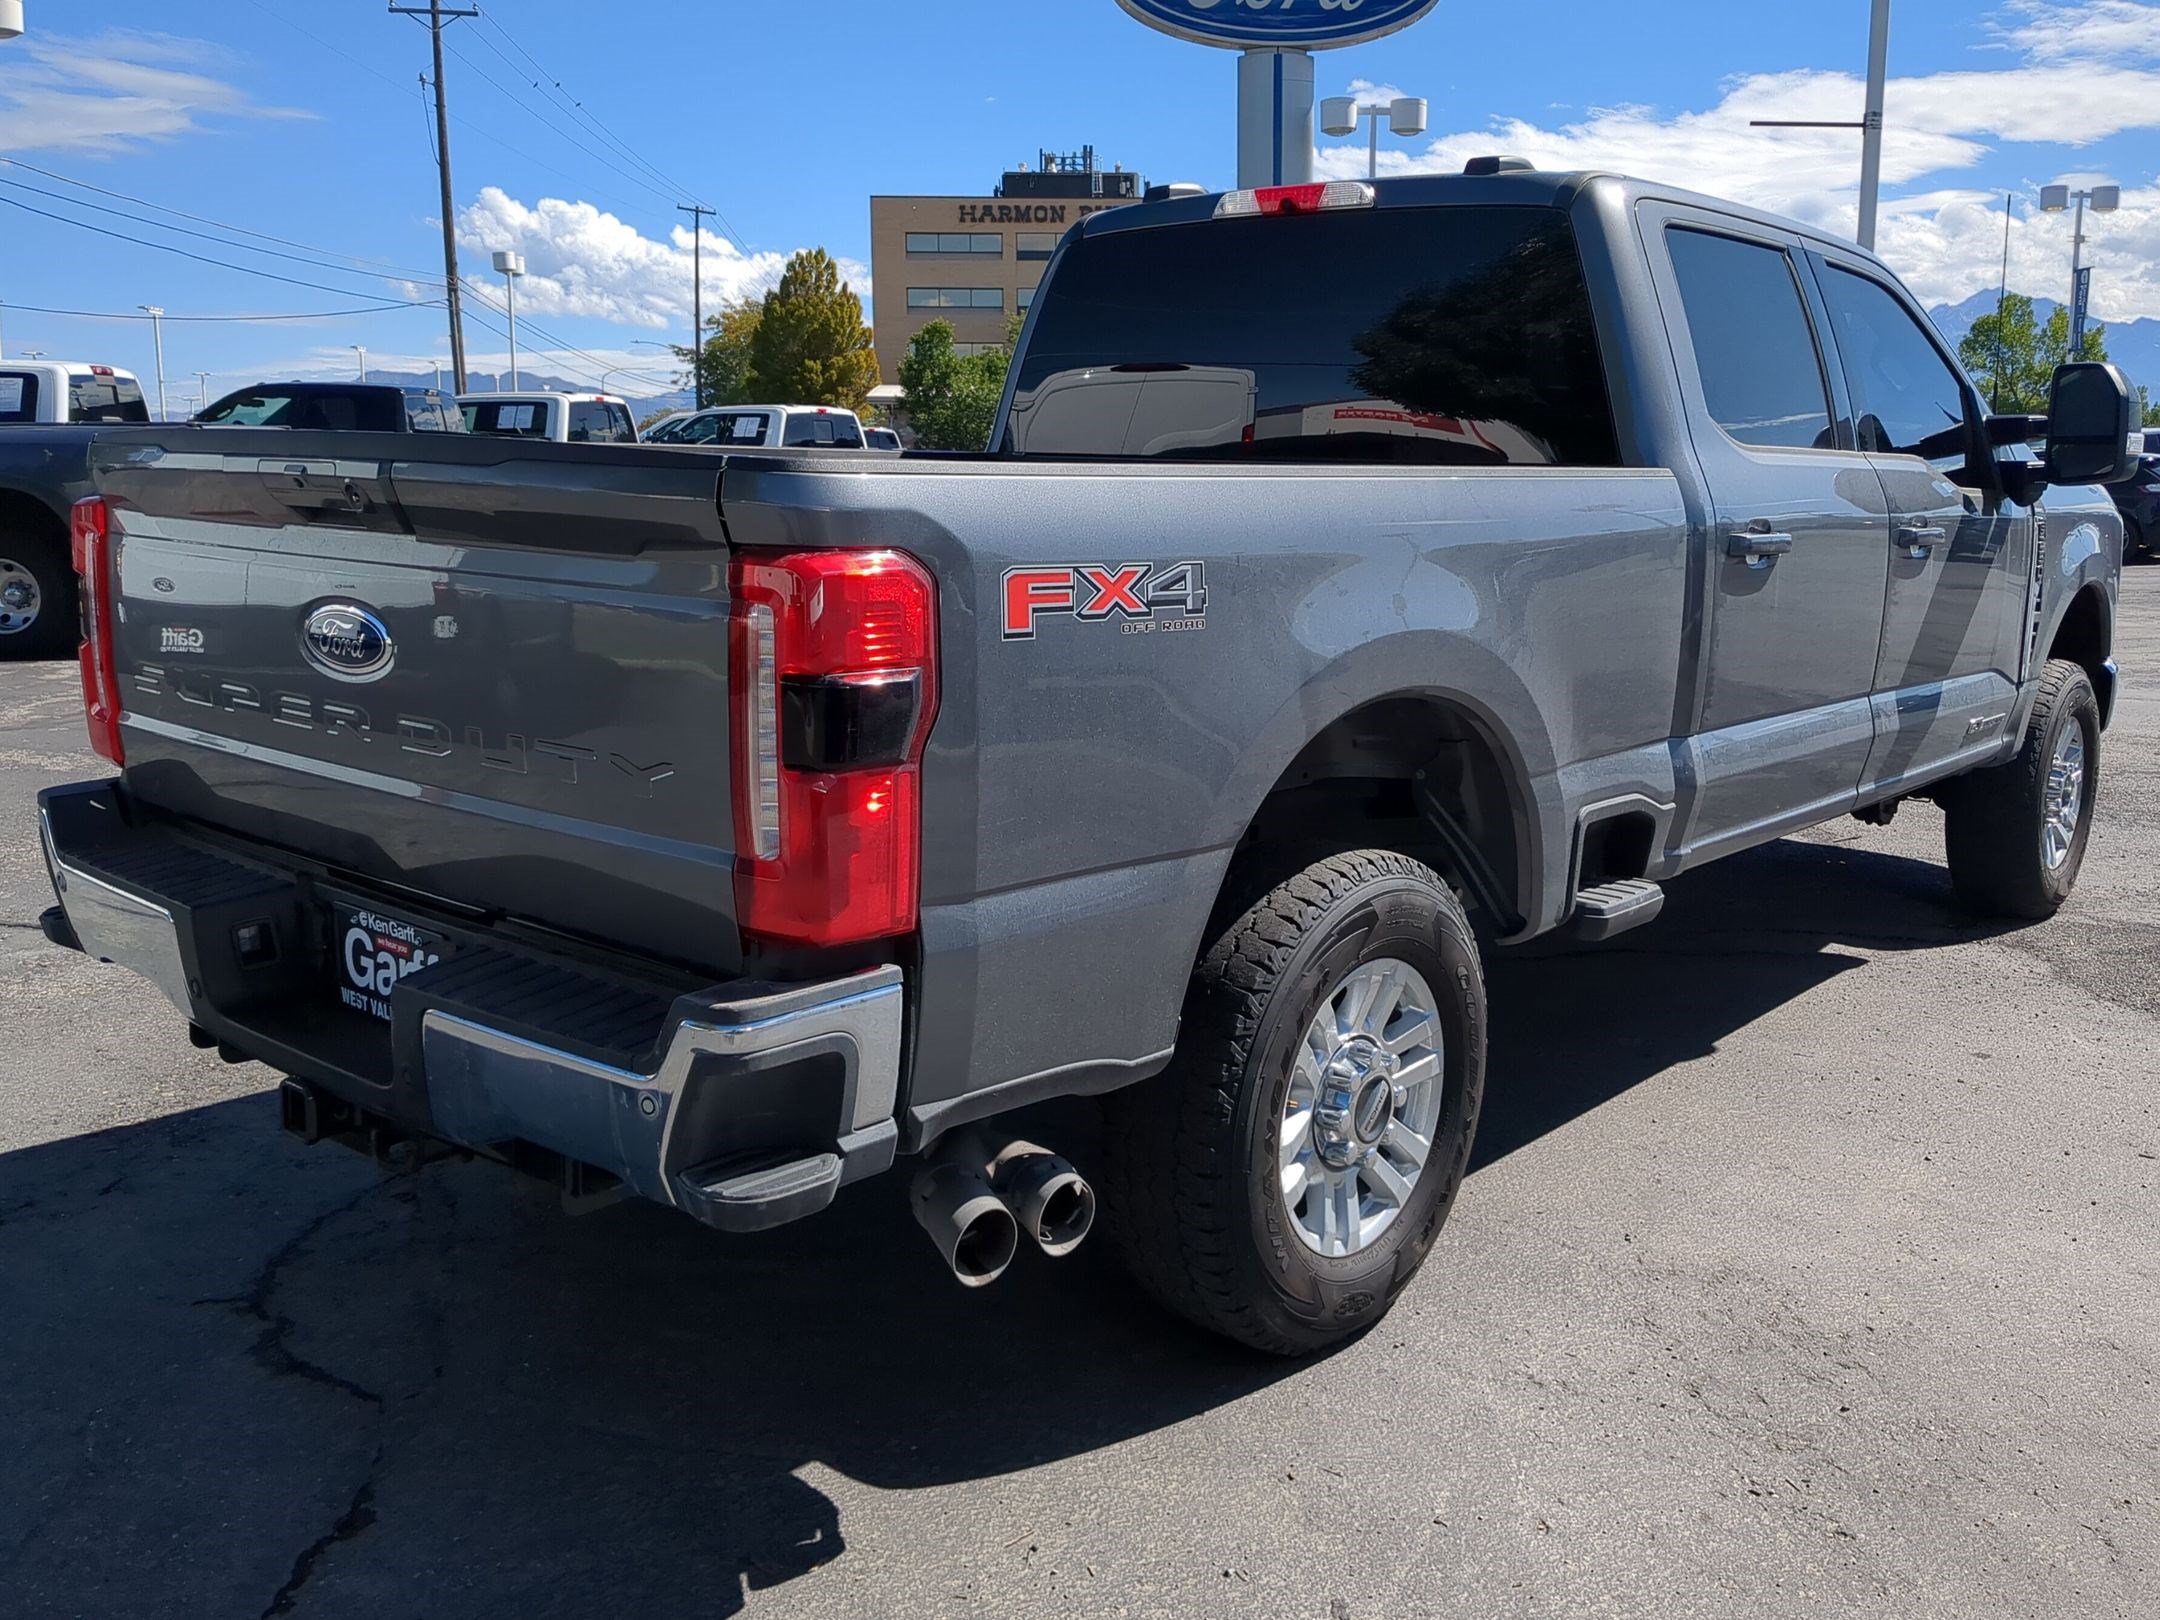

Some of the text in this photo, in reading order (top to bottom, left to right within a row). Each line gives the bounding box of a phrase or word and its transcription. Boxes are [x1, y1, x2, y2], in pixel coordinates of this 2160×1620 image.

[958, 204, 1066, 224] HARMON
[1000, 560, 1208, 642] FX4
[316, 617, 367, 660] Ford
[1120, 619, 1206, 635] OFF ROAD
[133, 664, 372, 743] SUPER
[397, 712, 675, 799] DUTY
[367, 912, 416, 944] Ken Garff
[385, 939, 398, 950] hear
[397, 944, 408, 954] you
[340, 986, 392, 1020] WEST VAL
[1421, 962, 1481, 1248] GOODYEAR
